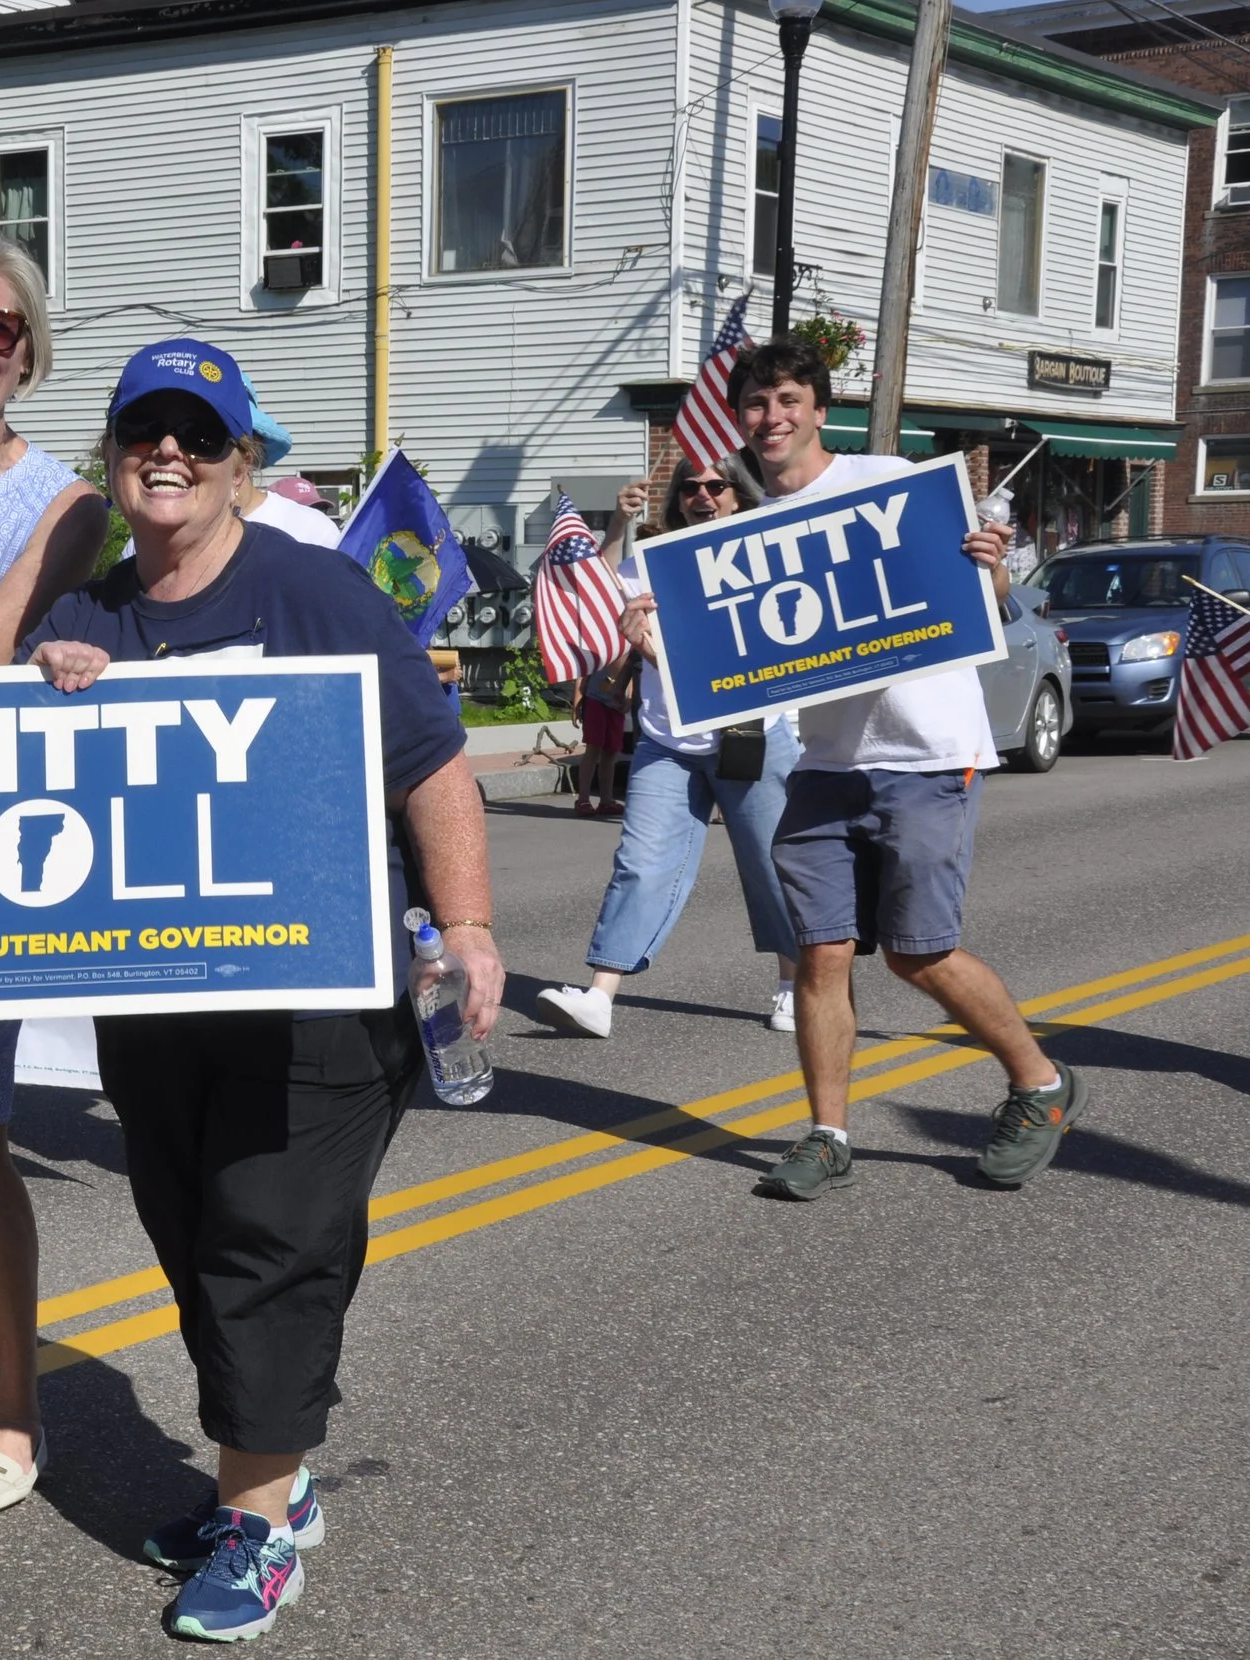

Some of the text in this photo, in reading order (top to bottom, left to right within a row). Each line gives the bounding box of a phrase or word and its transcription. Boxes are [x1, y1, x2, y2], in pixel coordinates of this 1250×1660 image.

[152, 352, 197, 360] WATERBURY
[157, 358, 196, 369] Rotary
[174, 367, 194, 376] CLUB
[1034, 357, 1106, 386] BARGAIN BOUTIQUE
[696, 492, 909, 597] KITTY
[707, 558, 927, 656] TOLL
[711, 674, 746, 693] FOR
[749, 646, 853, 685] LIEUTENANT
[856, 622, 953, 656] GOVERNOR
[138, 923, 310, 950] GOVERNOR
[5, 976, 13, 984] by
[14, 975, 31, 983] Kitty
[124, 970, 161, 978] Burlington,
[175, 968, 199, 976] 05402
